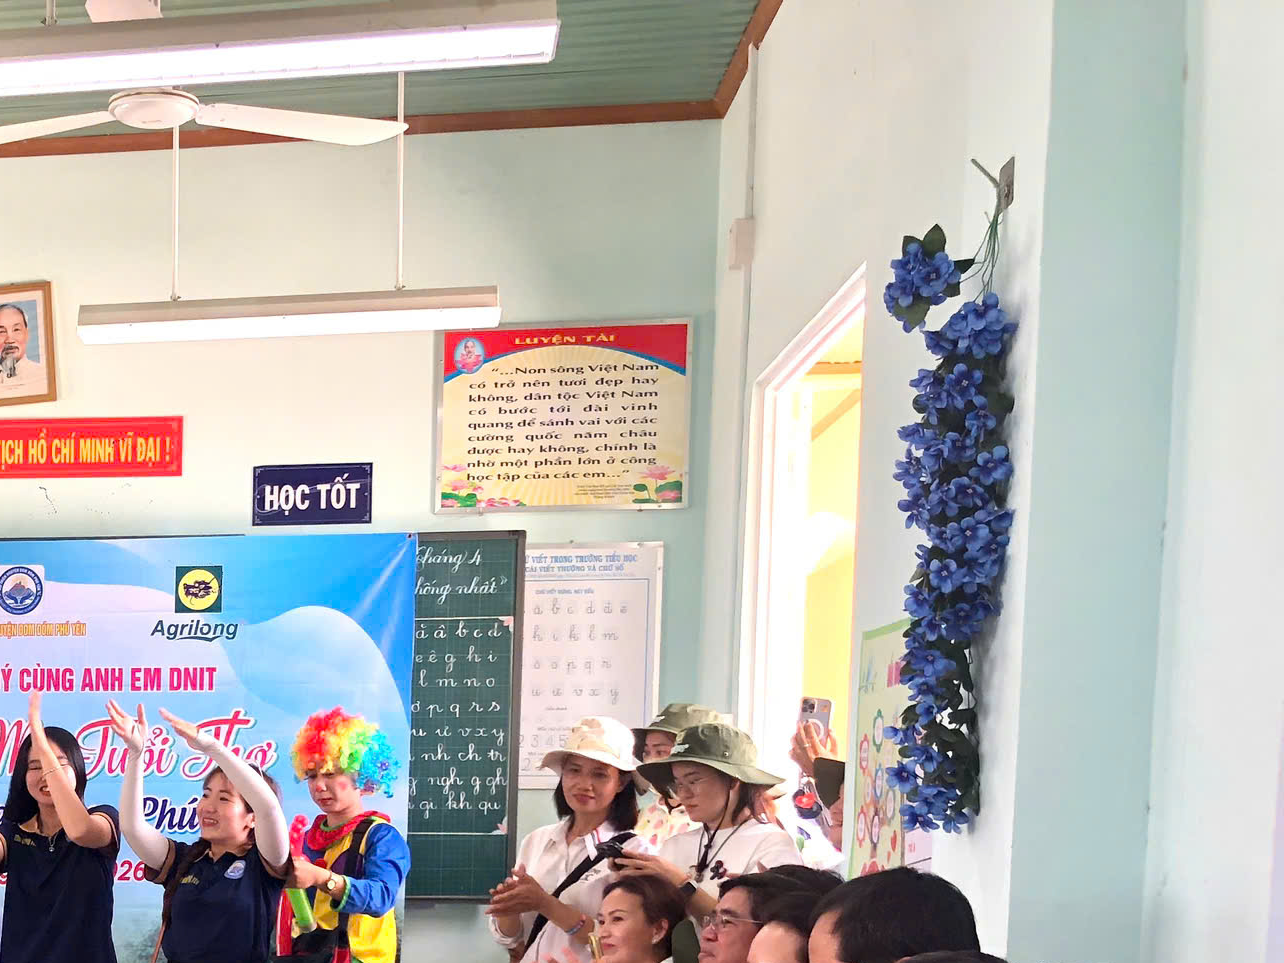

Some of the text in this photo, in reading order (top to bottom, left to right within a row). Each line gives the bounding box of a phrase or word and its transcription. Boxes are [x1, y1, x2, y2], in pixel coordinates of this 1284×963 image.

[515, 333, 615, 346] LUYỆN TÀI
[550, 365, 584, 376] sông
[588, 364, 617, 373] Việt
[622, 363, 659, 371] Nam
[469, 377, 659, 390] có trở nên tươi đẹp hay
[469, 390, 658, 404] không, dân tộc Việt Nam
[469, 402, 658, 416] có bước tới đài vinh
[468, 415, 657, 431] quang để sánh vai với các
[468, 429, 657, 444] cường quốc năm châu
[28, 428, 48, 464] HỒ
[52, 433, 75, 463] CHÍ
[79, 439, 114, 463] MINH
[118, 436, 133, 462] VĨ
[137, 438, 160, 464] ĐẠI
[165, 437, 170, 461] !
[467, 442, 656, 457] được hay không, chính là
[467, 455, 656, 470] nhờ một phần lớn ở công
[466, 472, 492, 483] học
[497, 471, 521, 482] tập
[524, 471, 549, 480] của
[553, 470, 579, 479] các
[264, 473, 360, 516] HỌC TỐT
[468, 548, 481, 565] 4
[150, 619, 239, 641] Agrilong
[19, 663, 73, 692] CÙNG
[81, 667, 123, 692] ANH
[131, 667, 161, 691] EM
[169, 666, 217, 691] DNIT
[421, 743, 506, 762] nh ch tr
[427, 767, 507, 794] ngh gh
[419, 792, 501, 819] gi kh qu
